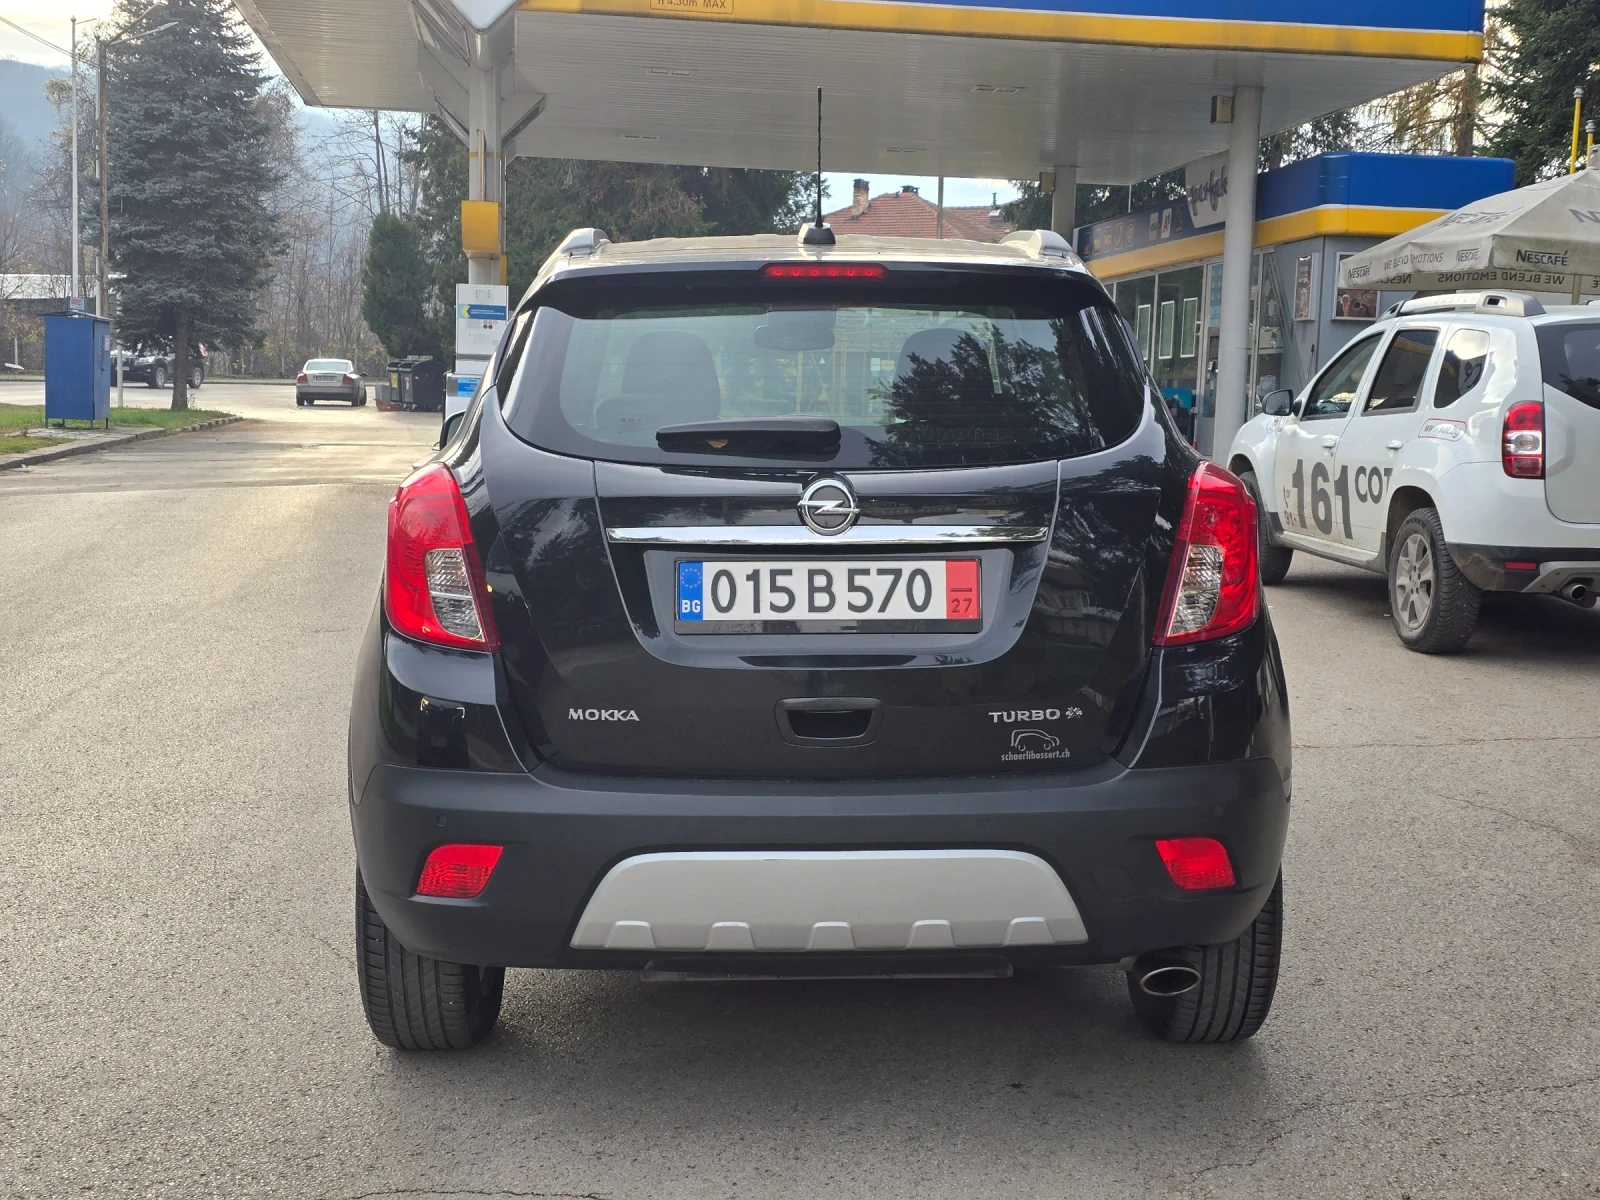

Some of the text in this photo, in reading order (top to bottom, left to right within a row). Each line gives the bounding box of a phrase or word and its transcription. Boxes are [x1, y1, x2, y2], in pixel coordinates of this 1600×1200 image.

[703, 0, 727, 9] MAX
[1384, 258, 1393, 271] WE
[1515, 249, 1569, 267] NESCAFÉ
[1292, 458, 1354, 541] 161
[681, 600, 701, 614] BG
[950, 598, 973, 614] 27
[568, 708, 641, 722] MOKKA
[988, 708, 1061, 723] TURBO
[1000, 747, 1071, 762] schaerlibossert.ch
